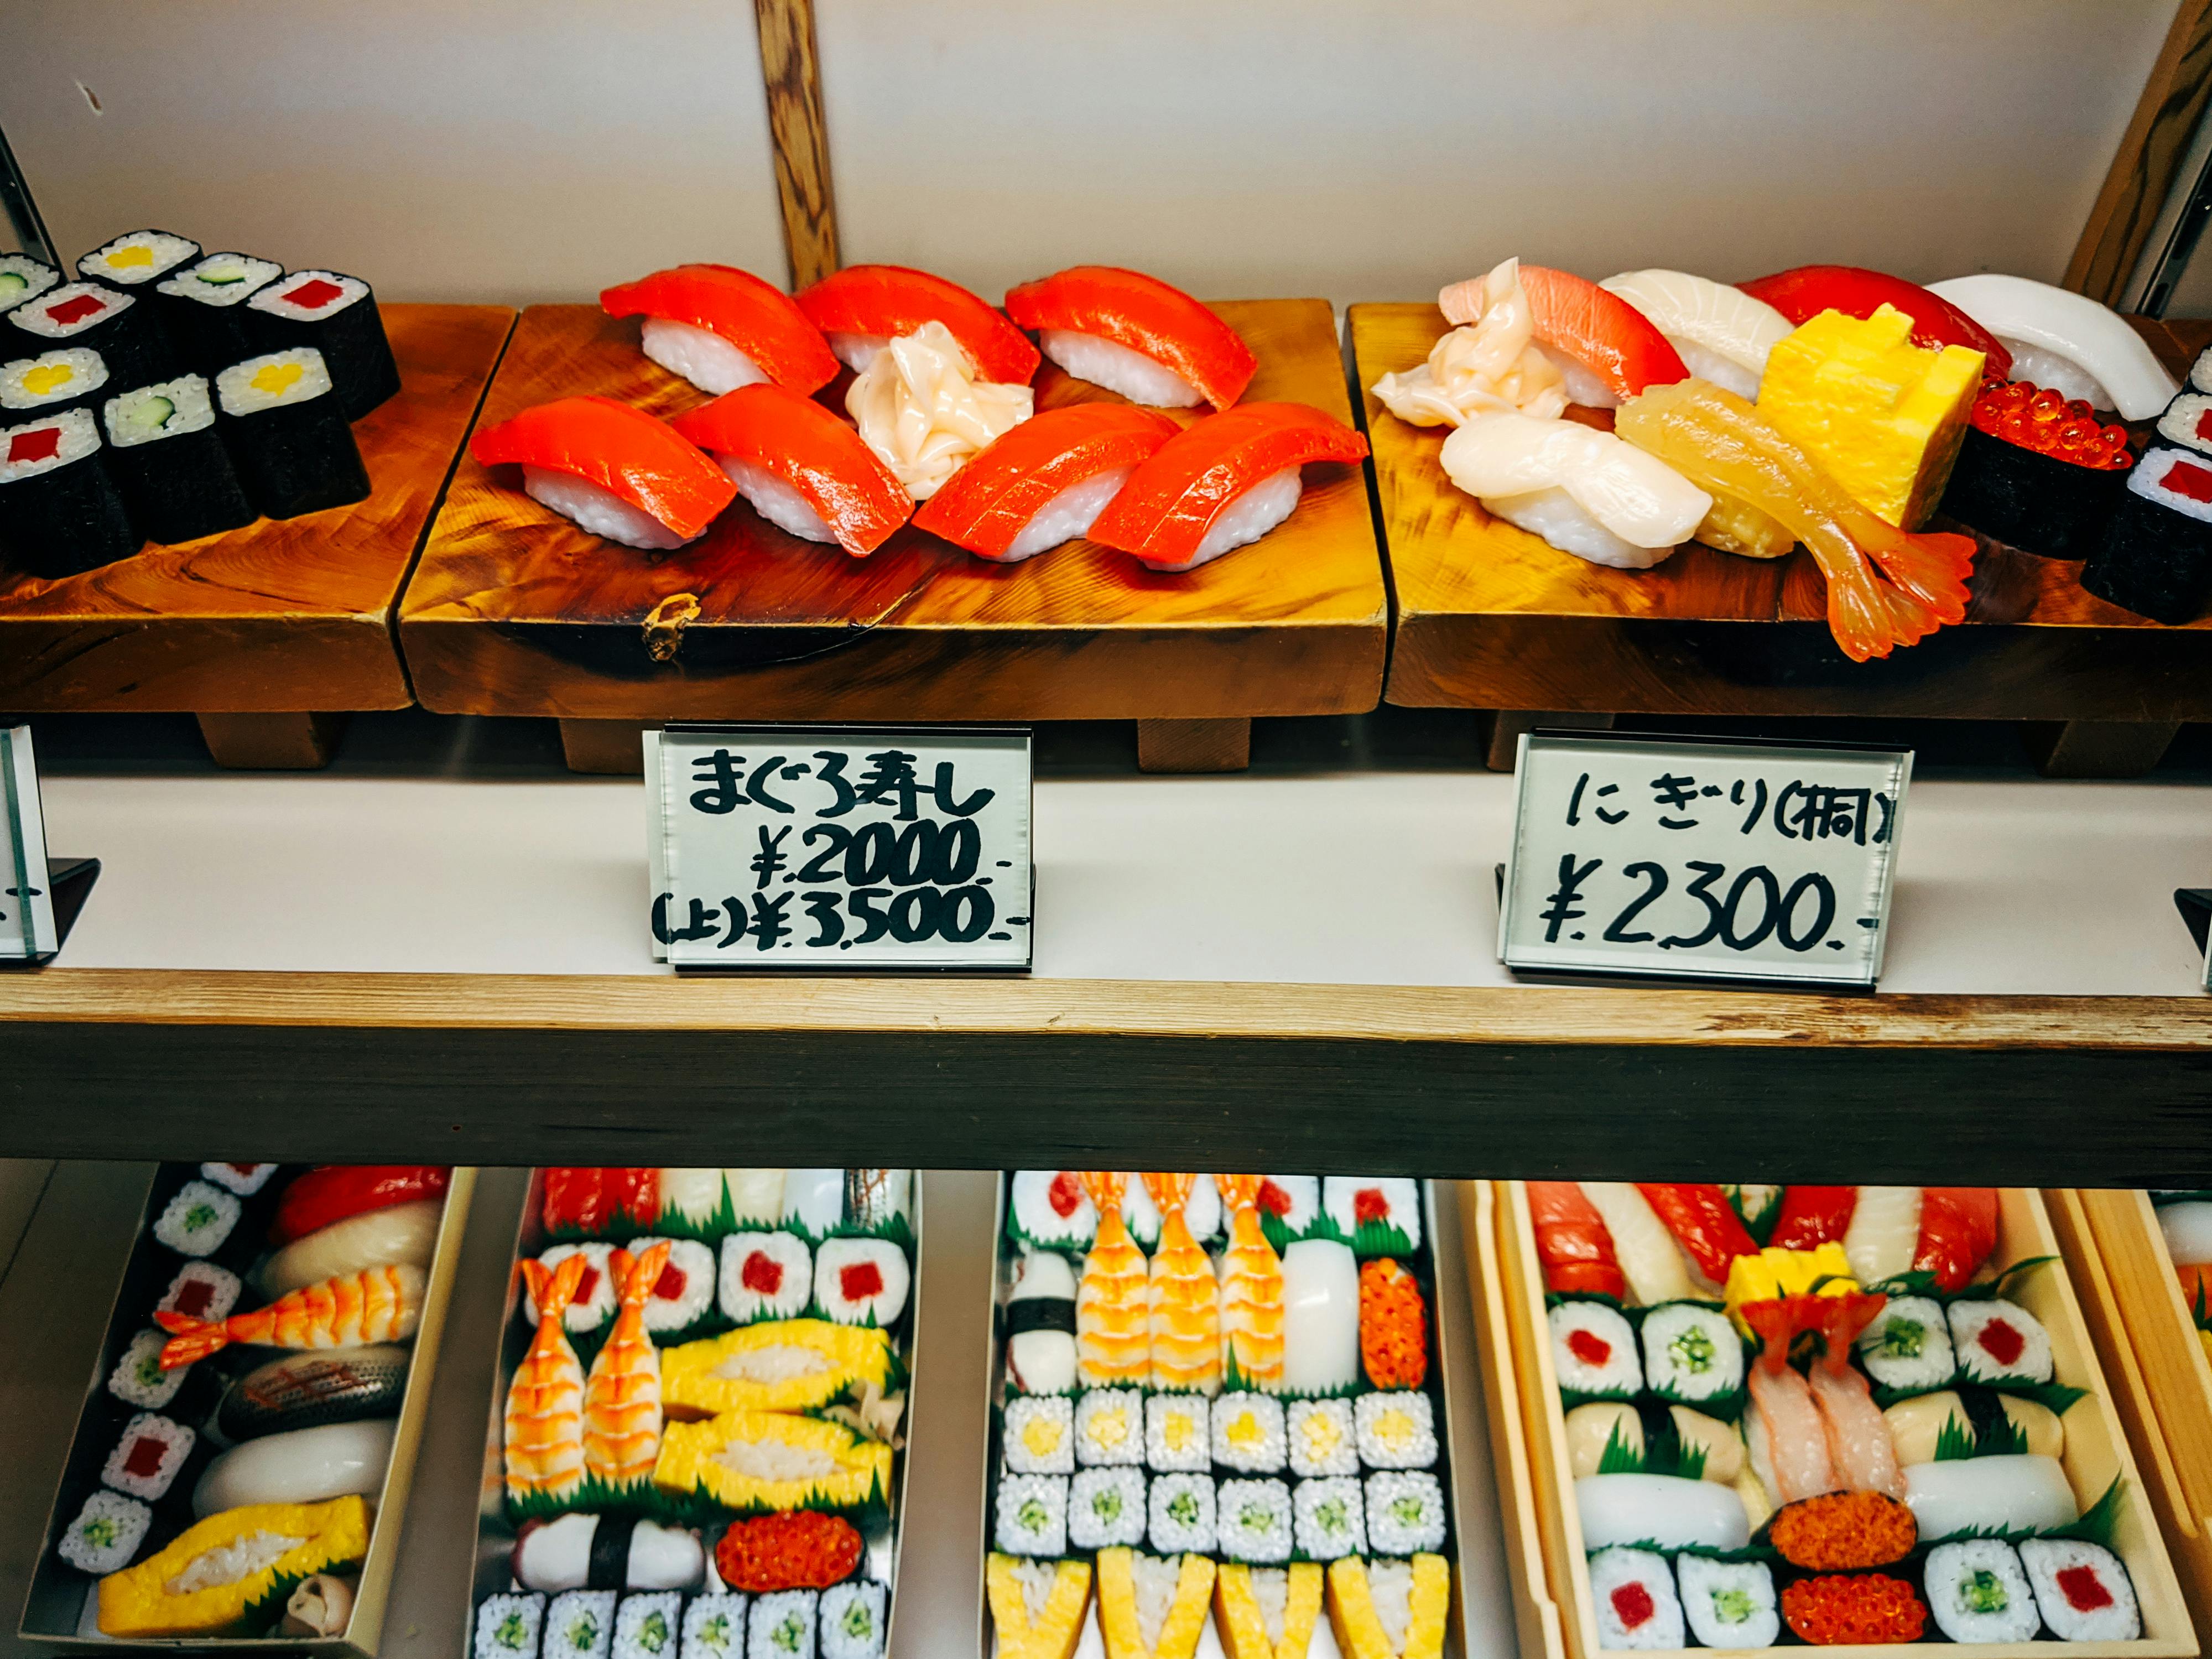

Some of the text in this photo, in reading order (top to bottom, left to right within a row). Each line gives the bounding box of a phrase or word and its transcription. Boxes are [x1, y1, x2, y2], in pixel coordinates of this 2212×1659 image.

[690, 749, 995, 820] まぐろ寿し
